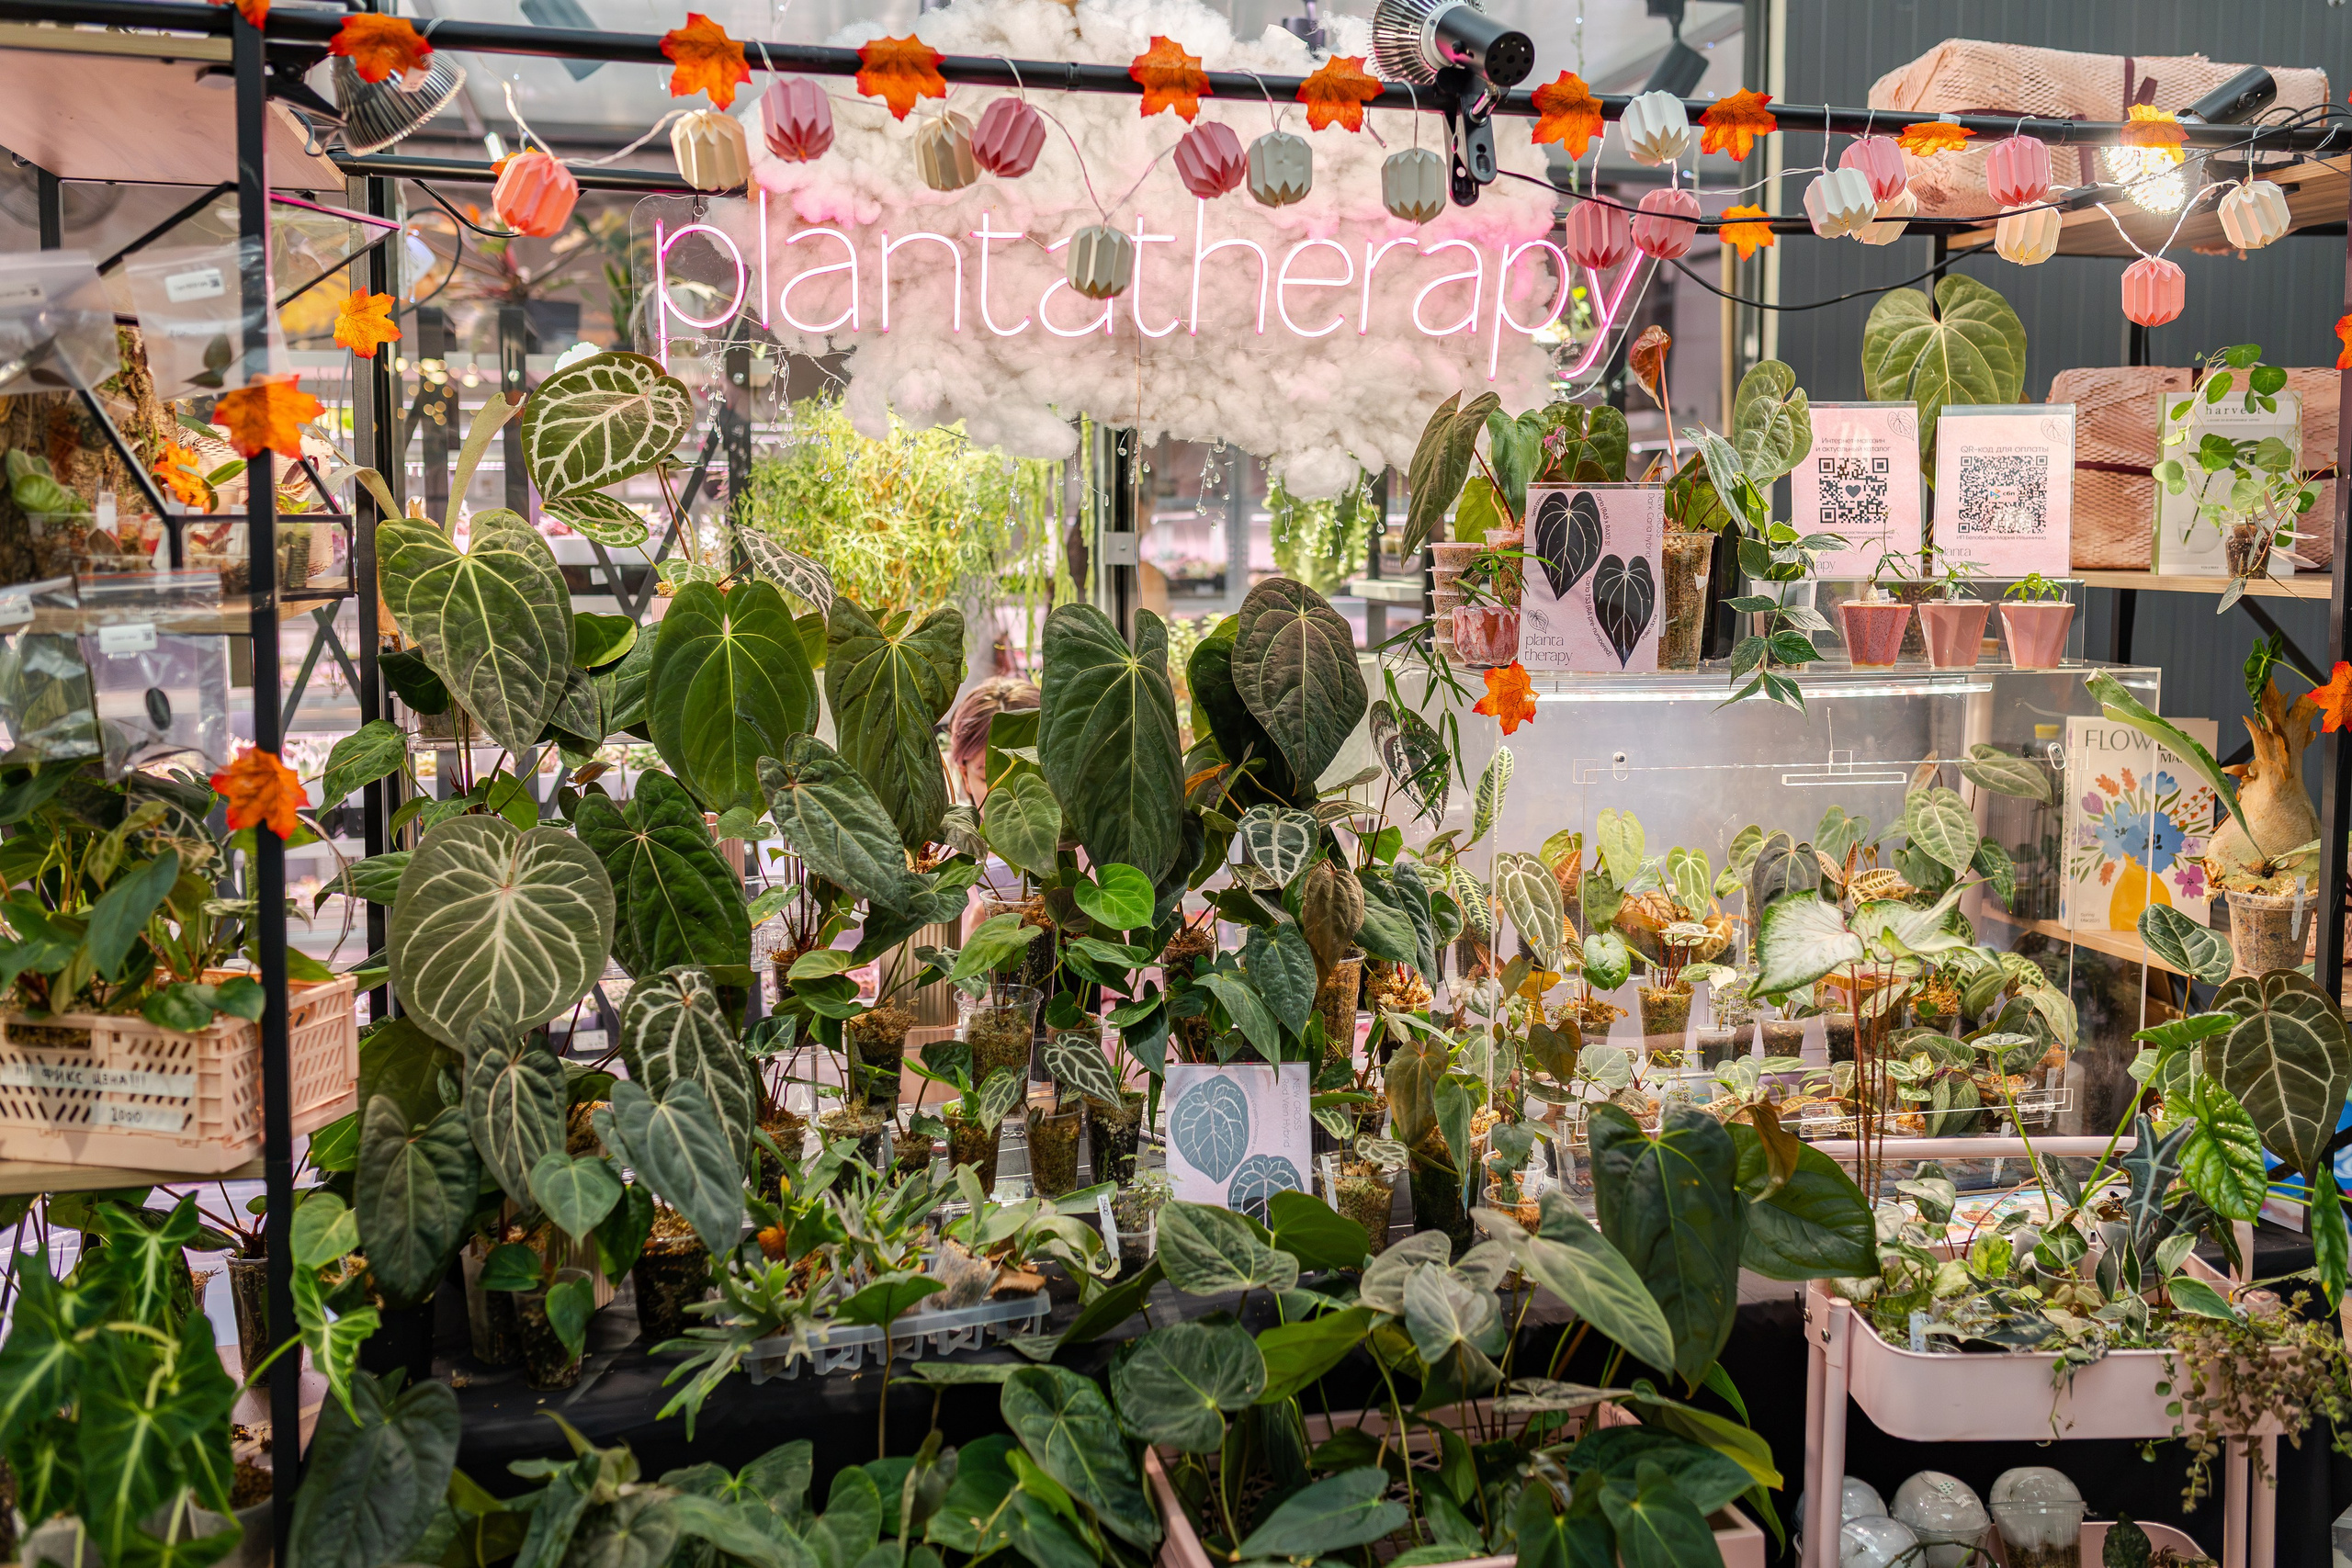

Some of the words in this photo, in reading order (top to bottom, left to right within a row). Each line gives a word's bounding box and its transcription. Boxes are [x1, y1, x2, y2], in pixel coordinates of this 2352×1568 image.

[2206, 405, 2261, 414] harvet
[1960, 446, 1994, 454] QR-код
[1996, 446, 2012, 454] для
[1647, 492, 1656, 511] Dark
[1646, 512, 1655, 533] Carla
[1645, 534, 1653, 558] hybrid
[1525, 634, 1564, 649] planta
[1524, 649, 1573, 666] therapy
[2086, 729, 2188, 751] FLOW
[2160, 753, 2183, 763] MA
[41, 1067, 84, 1084] ФИКС
[1282, 1077, 1290, 1095] Red
[1292, 1077, 1301, 1098] NEW
[1282, 1097, 1290, 1116] Vein
[1293, 1100, 1302, 1131] CROSS
[1281, 1118, 1291, 1148] Hybrid
